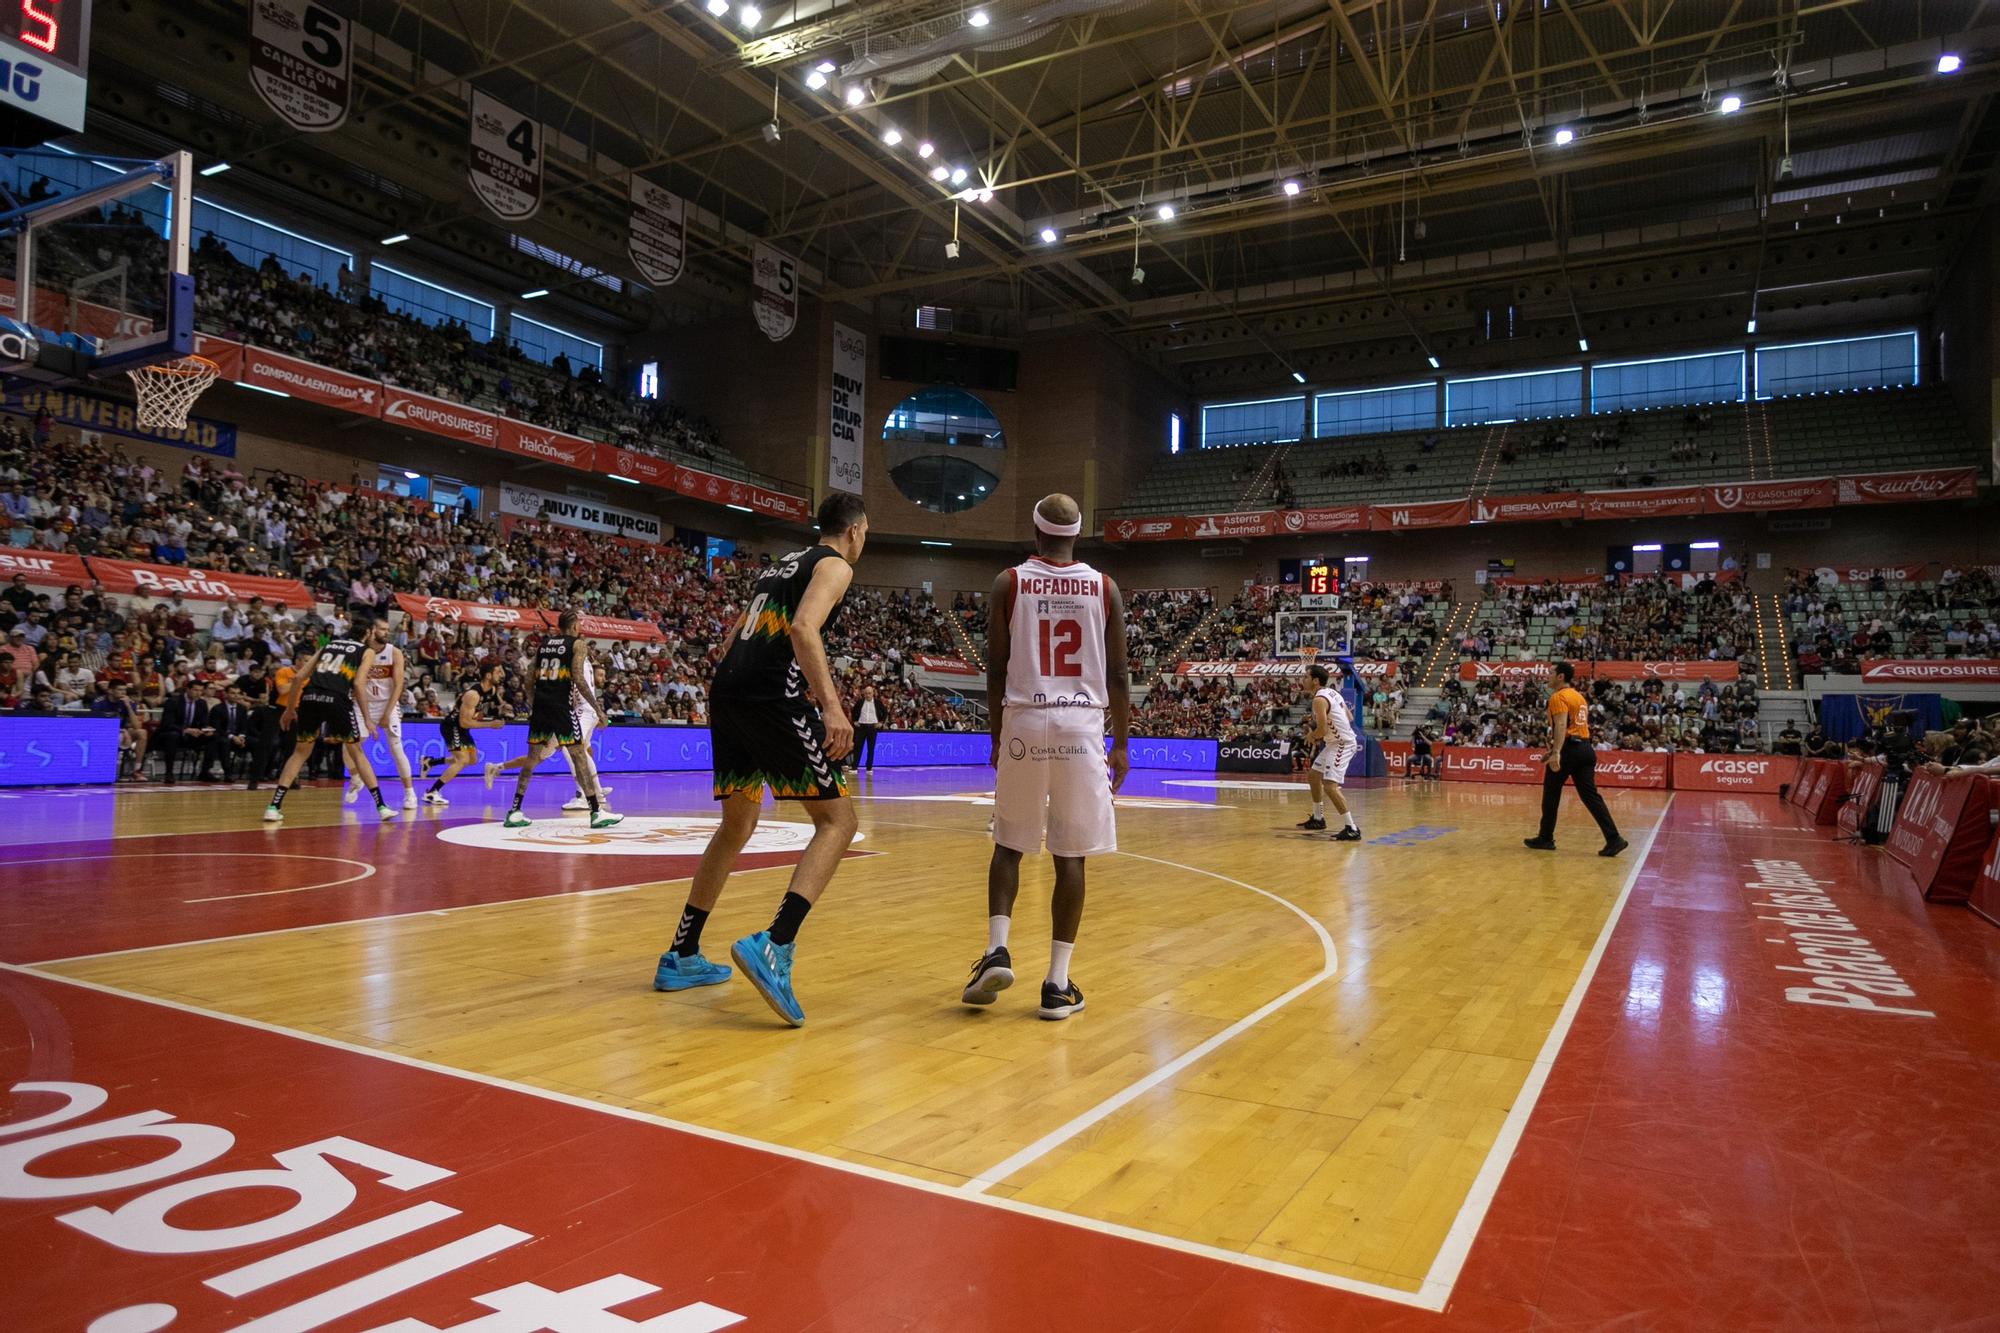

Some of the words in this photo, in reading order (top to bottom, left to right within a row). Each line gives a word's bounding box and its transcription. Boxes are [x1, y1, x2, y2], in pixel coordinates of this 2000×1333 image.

[303, 6, 342, 68] 5
[261, 45, 337, 90] CAMPEÓN
[281, 66, 318, 92] LIGA
[507, 120, 536, 166] 4
[489, 165, 521, 188] COPA
[779, 260, 794, 295] 5
[252, 363, 358, 400] COMPRALAENTRADA
[833, 372, 862, 396] MUY
[833, 389, 849, 408] DE
[407, 404, 494, 438] GRUPOSURESTE
[832, 405, 862, 428] MUR
[832, 422, 855, 442] CIA
[752, 490, 786, 512] Lunia
[1501, 503, 1540, 513] IBERIA
[1541, 500, 1577, 510] VITAE
[1656, 496, 1697, 506] LEVANTE
[543, 498, 578, 518] MUY
[582, 507, 600, 523] DE
[602, 510, 659, 536] MURCIA
[1223, 514, 1261, 525] Asterra
[1148, 522, 1173, 534] ESP
[1223, 524, 1266, 535] Partners
[131, 568, 237, 597] Barin
[1020, 577, 1099, 597] MCFADDEN
[1310, 577, 1327, 593] 15
[486, 608, 520, 622] ESP
[1038, 618, 1082, 677] 12
[1189, 663, 1237, 674] ZONA
[1893, 666, 2000, 676] GRUPOSURE
[1030, 745, 1056, 755] Costa
[1058, 744, 1088, 755] Cálida
[1220, 744, 1282, 760] endesa
[1447, 756, 1505, 771] Lunia
[1713, 760, 1769, 775] caser
[1716, 775, 1753, 785] seguros
[1766, 931, 1937, 1018] Palacio
